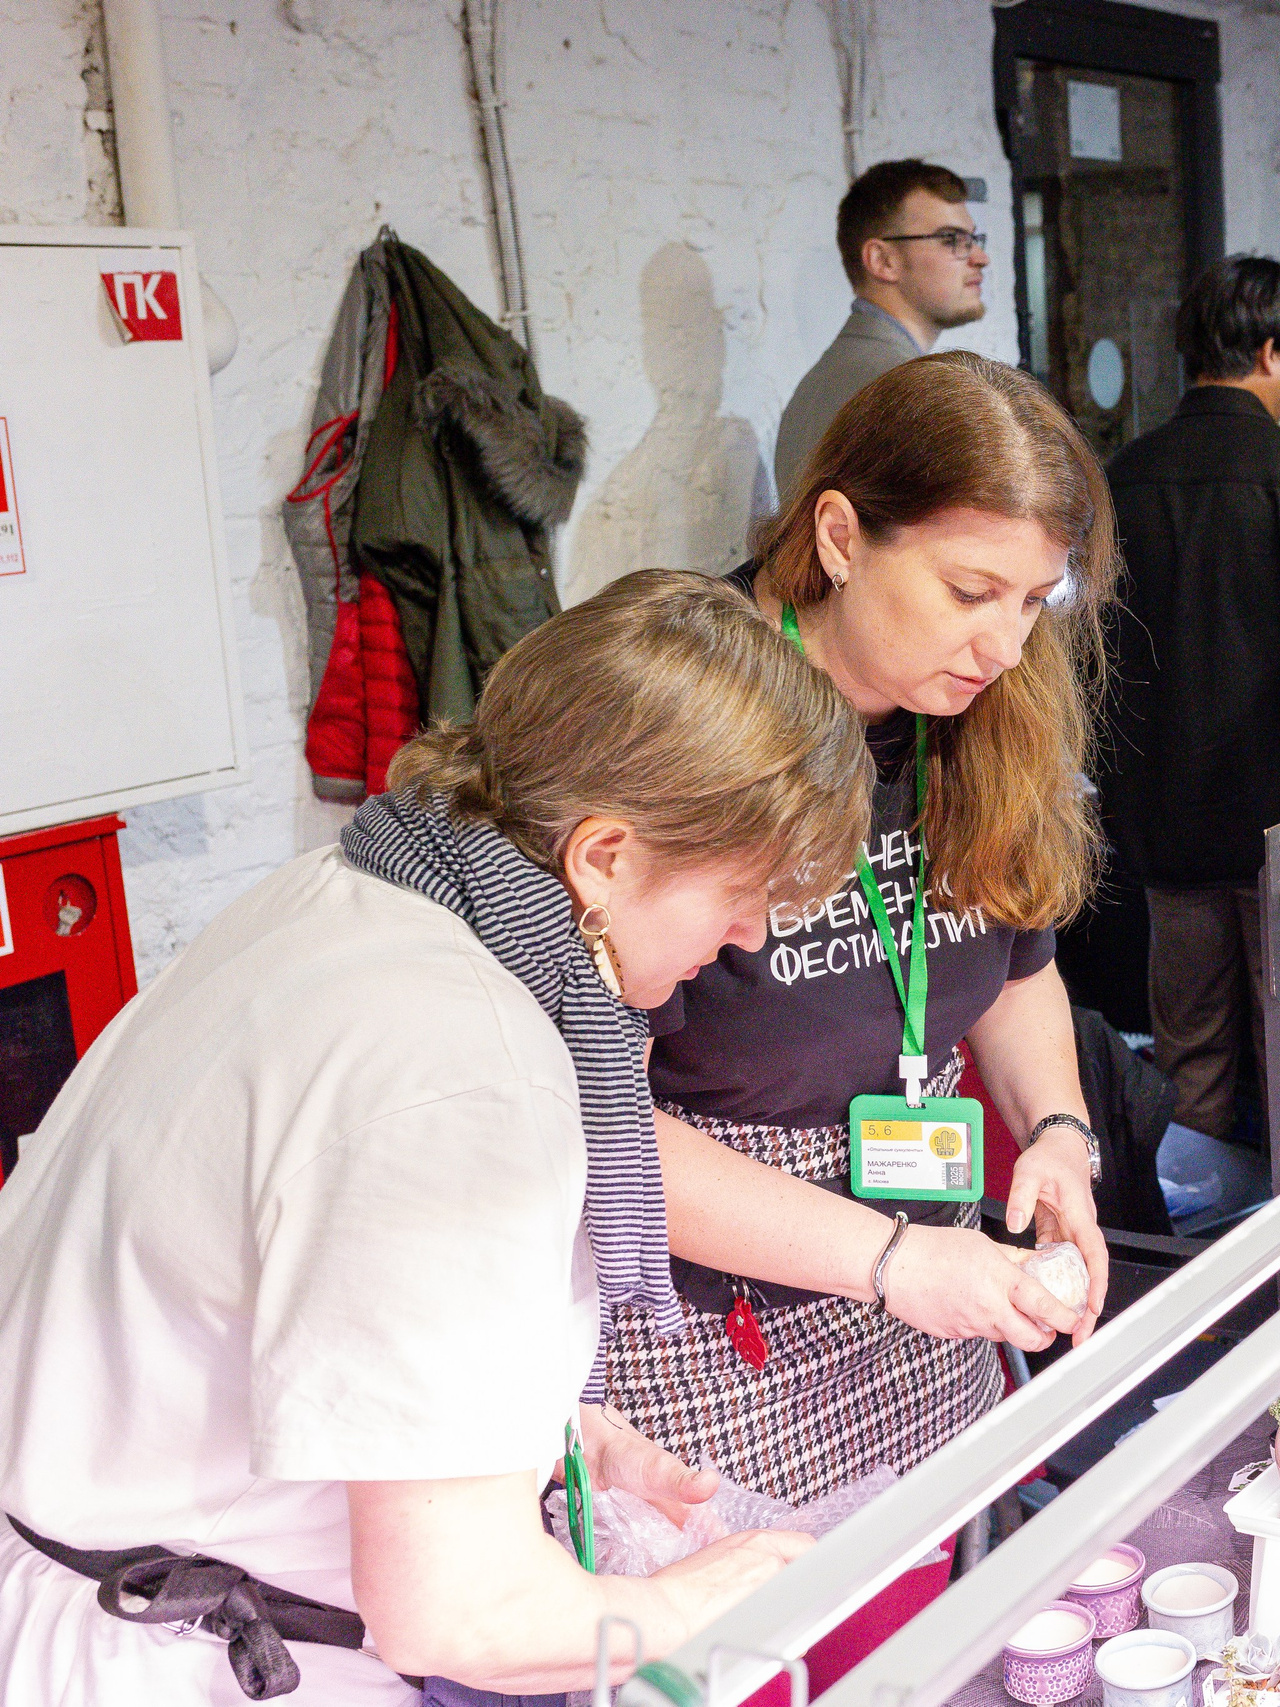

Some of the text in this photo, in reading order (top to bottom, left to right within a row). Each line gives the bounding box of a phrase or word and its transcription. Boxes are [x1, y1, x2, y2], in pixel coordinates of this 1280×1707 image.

[113, 273, 169, 320] ПК
[868, 1125, 892, 1137] 5, 6
[950, 1166, 959, 1186] 2025
